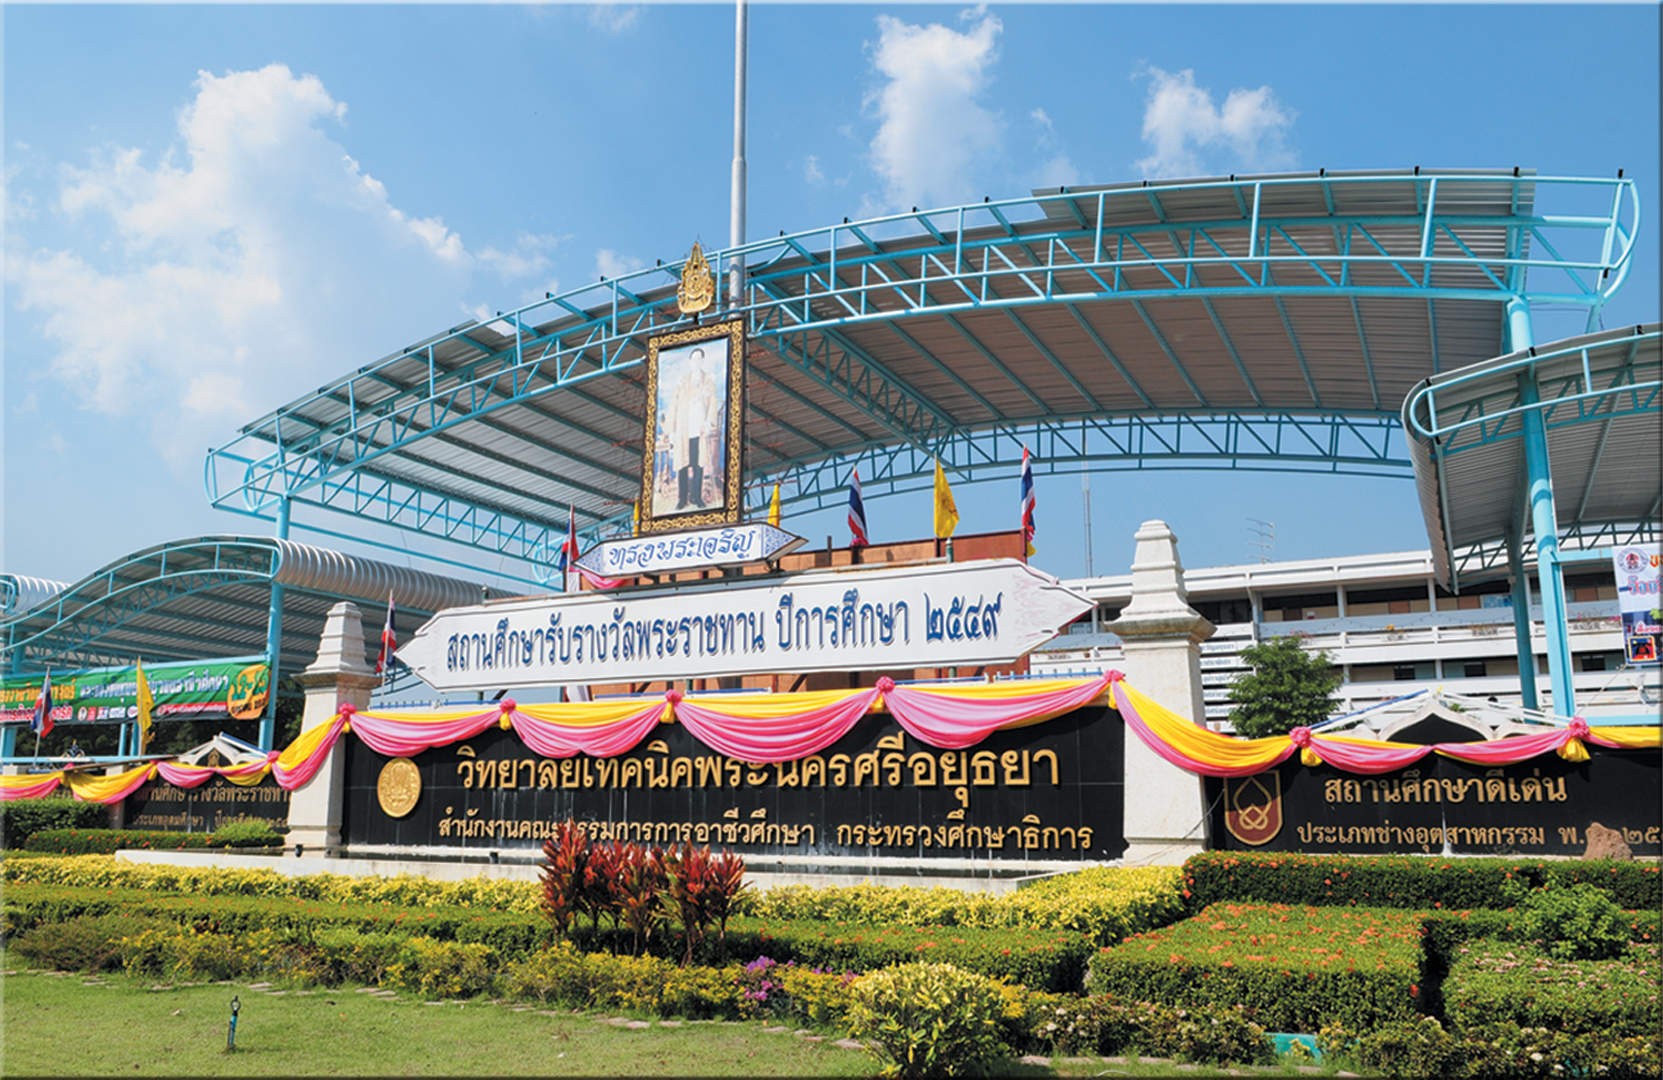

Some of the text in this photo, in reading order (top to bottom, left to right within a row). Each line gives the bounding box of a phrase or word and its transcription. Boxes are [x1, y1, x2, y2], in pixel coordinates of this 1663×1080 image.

[608, 528, 756, 570] ทรงพระเจริญ
[447, 587, 1003, 672] สถานศึกษารับรางวัลพระราชทาน ปีการศึกษา ๒๕๔๙
[457, 731, 1059, 808] วิทยาลยเทคนิคพระนครศรีอยุธยา
[1325, 768, 1567, 802] สถานศึกษาดีเด่น
[438, 806, 1094, 850] สำนักงานคณะรรมการการอาชีวศึกษา กระทรวงศึกษาธิการ
[1297, 820, 1545, 853] ประเภทช่างอุตสาหกรรม
